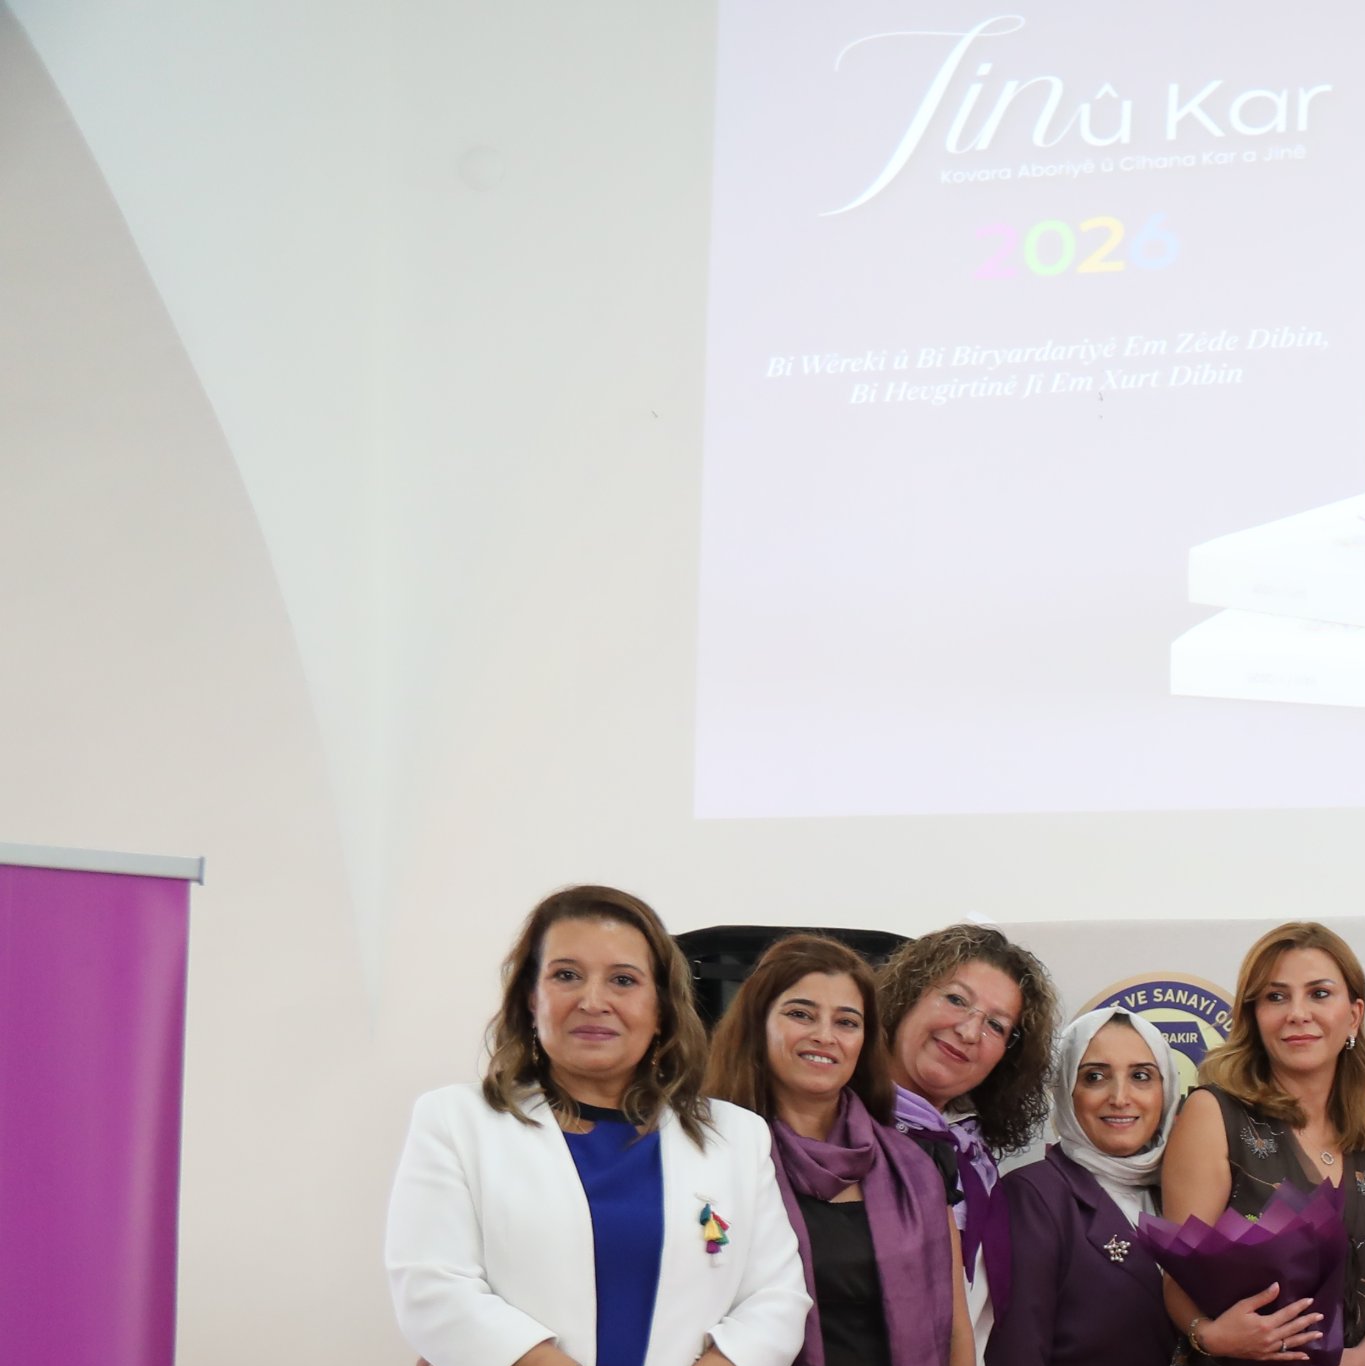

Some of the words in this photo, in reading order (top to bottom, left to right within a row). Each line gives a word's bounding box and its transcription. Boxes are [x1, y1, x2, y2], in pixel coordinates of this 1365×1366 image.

[817, 14, 1082, 217] Jin
[1079, 83, 1132, 147] û
[1165, 78, 1334, 141] Kar
[940, 167, 1012, 185] Kovara
[1202, 150, 1236, 166] Kar
[1243, 151, 1257, 163] a
[971, 209, 1182, 281] 2026
[765, 355, 796, 379] Bi
[916, 345, 946, 369] Bi
[1124, 334, 1168, 358] Em
[1176, 329, 1240, 354] Zêde
[1247, 324, 1330, 353] Dibin,
[849, 382, 878, 405] Bi
[1050, 371, 1094, 394] Em
[1100, 369, 1162, 391] Xurt
[1169, 360, 1246, 387] Dibin
[1125, 990, 1148, 1008] VE
[1153, 988, 1217, 1015] SANAYİ
[1162, 1032, 1198, 1044] BAKIR
